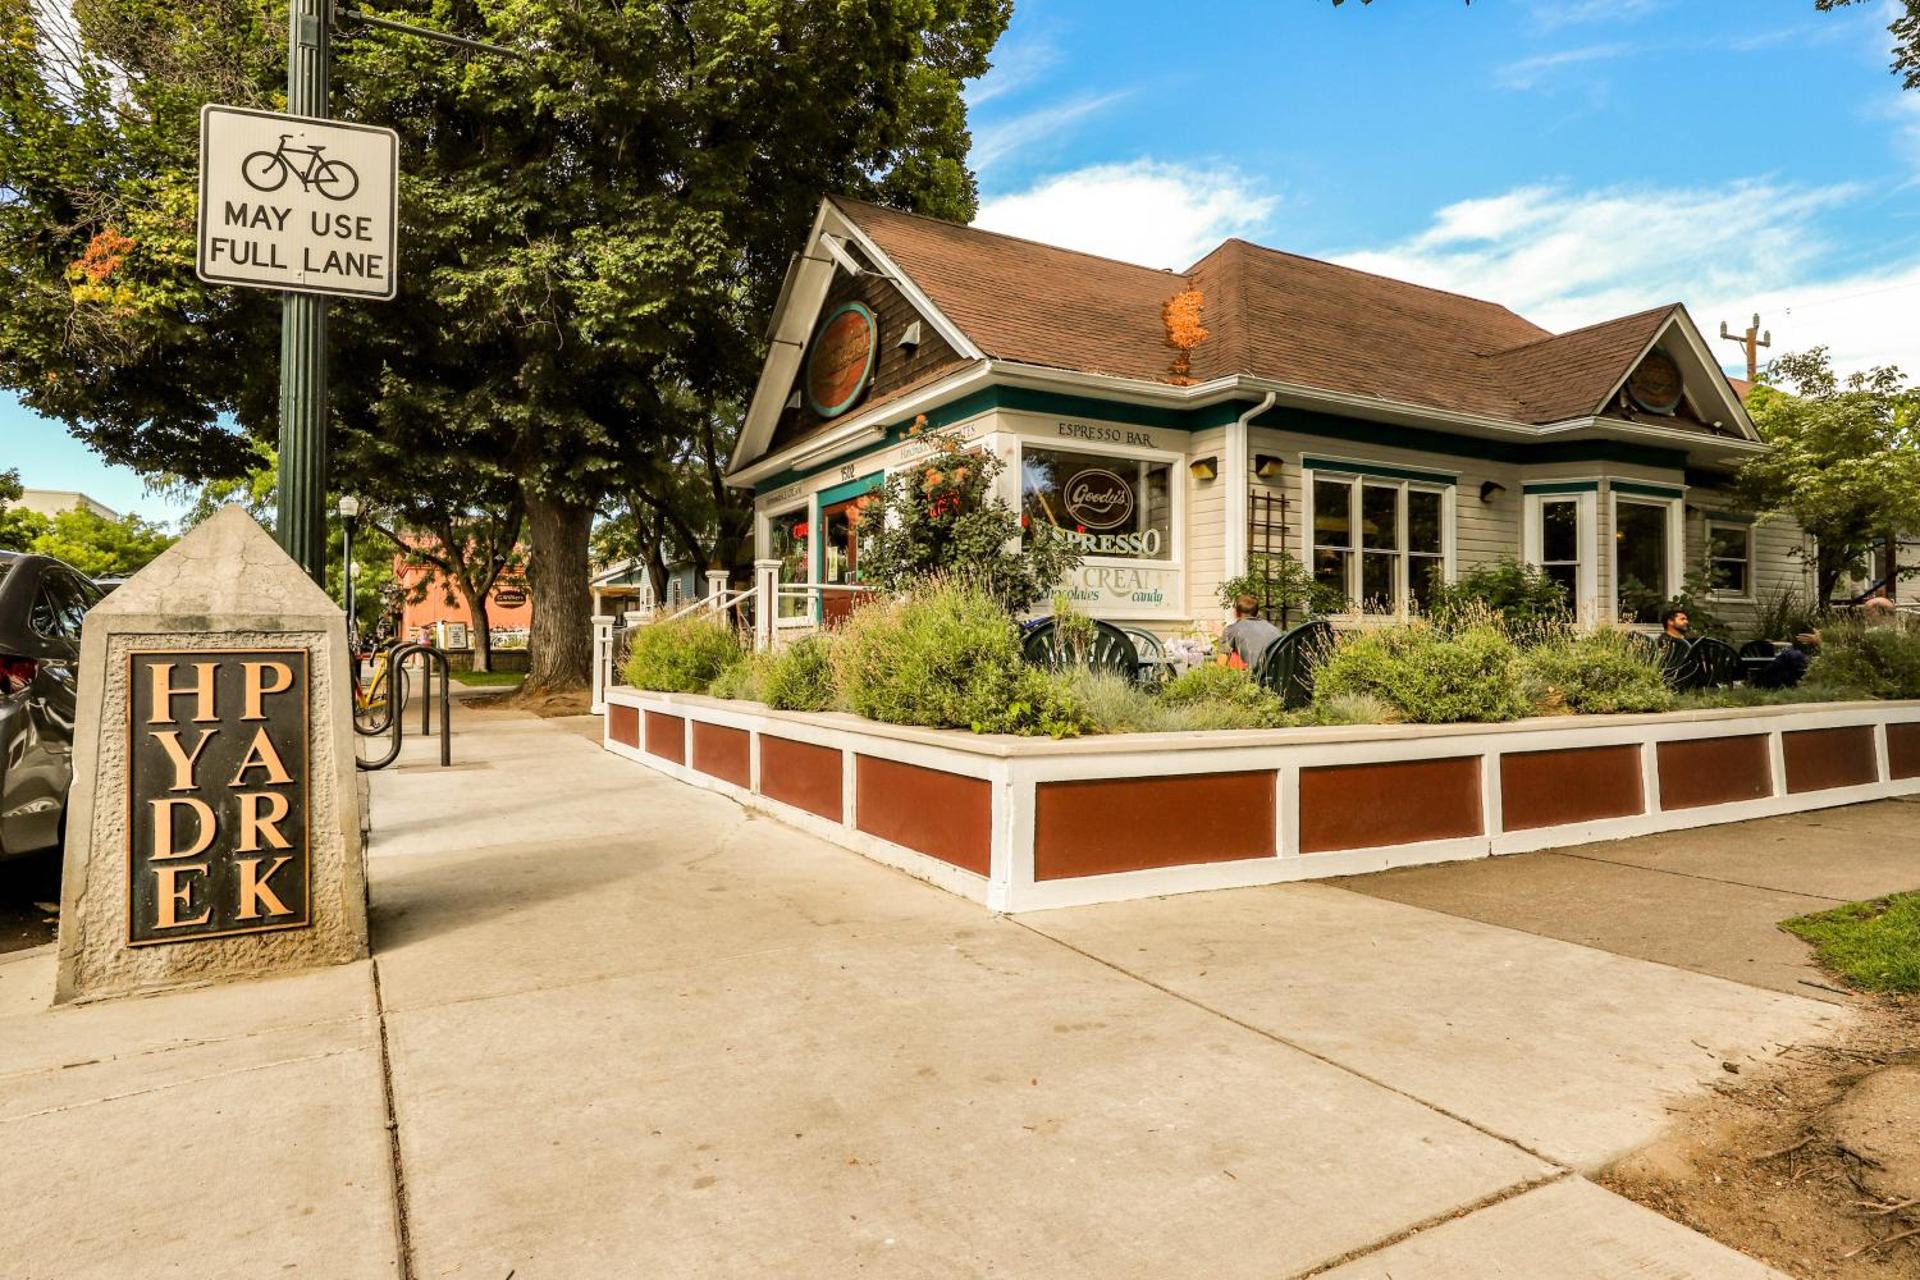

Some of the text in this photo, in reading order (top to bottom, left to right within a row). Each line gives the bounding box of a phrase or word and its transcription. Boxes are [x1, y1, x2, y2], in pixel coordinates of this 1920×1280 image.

[224, 201, 373, 242] MAY USE
[210, 237, 384, 279] FULL LANE
[1059, 423, 1157, 449] ESPRESSO BAR
[1071, 483, 1126, 513] Goody's
[1051, 527, 1160, 556] SPRESSO
[1040, 586, 1163, 607] cholates candy
[146, 662, 221, 930] HYDE
[228, 662, 295, 921] PARK
